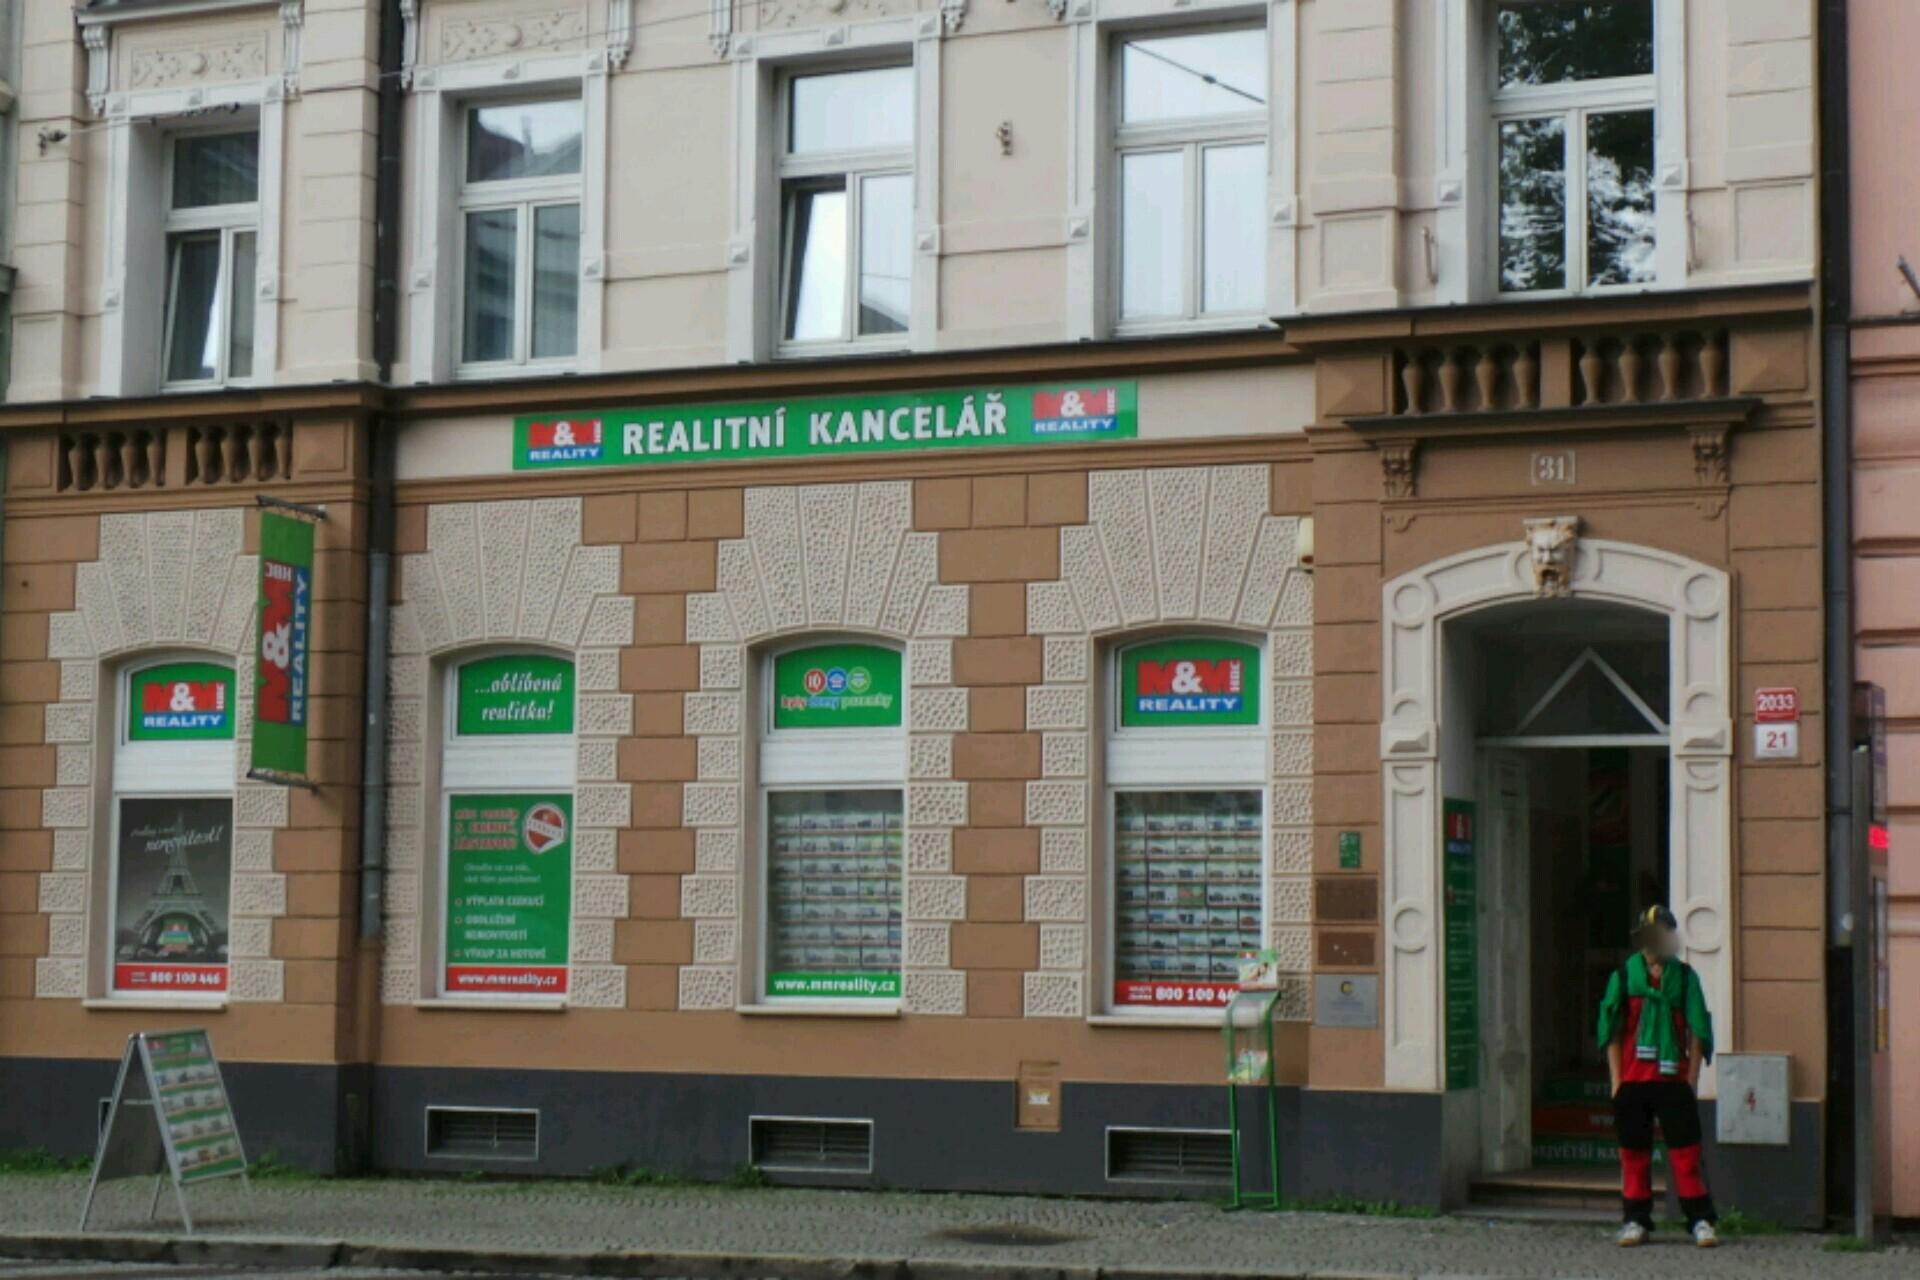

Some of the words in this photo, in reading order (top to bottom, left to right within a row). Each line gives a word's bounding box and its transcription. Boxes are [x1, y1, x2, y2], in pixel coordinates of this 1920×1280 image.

[623, 407, 786, 455] REALITNÍ
[809, 392, 1007, 445] KANCELÁŘ
[1034, 418, 1114, 433] REALITY
[530, 447, 600, 461] REALITY
[1539, 455, 1565, 481] 31
[291, 573, 308, 722] REALITY
[1139, 698, 1238, 712] REALITY
[143, 714, 222, 728] REALITY
[1766, 730, 1787, 749] 21
[774, 977, 896, 994] www.mmreality.cz
[1155, 985, 1183, 1000] 800
[1188, 987, 1214, 1001] 100
